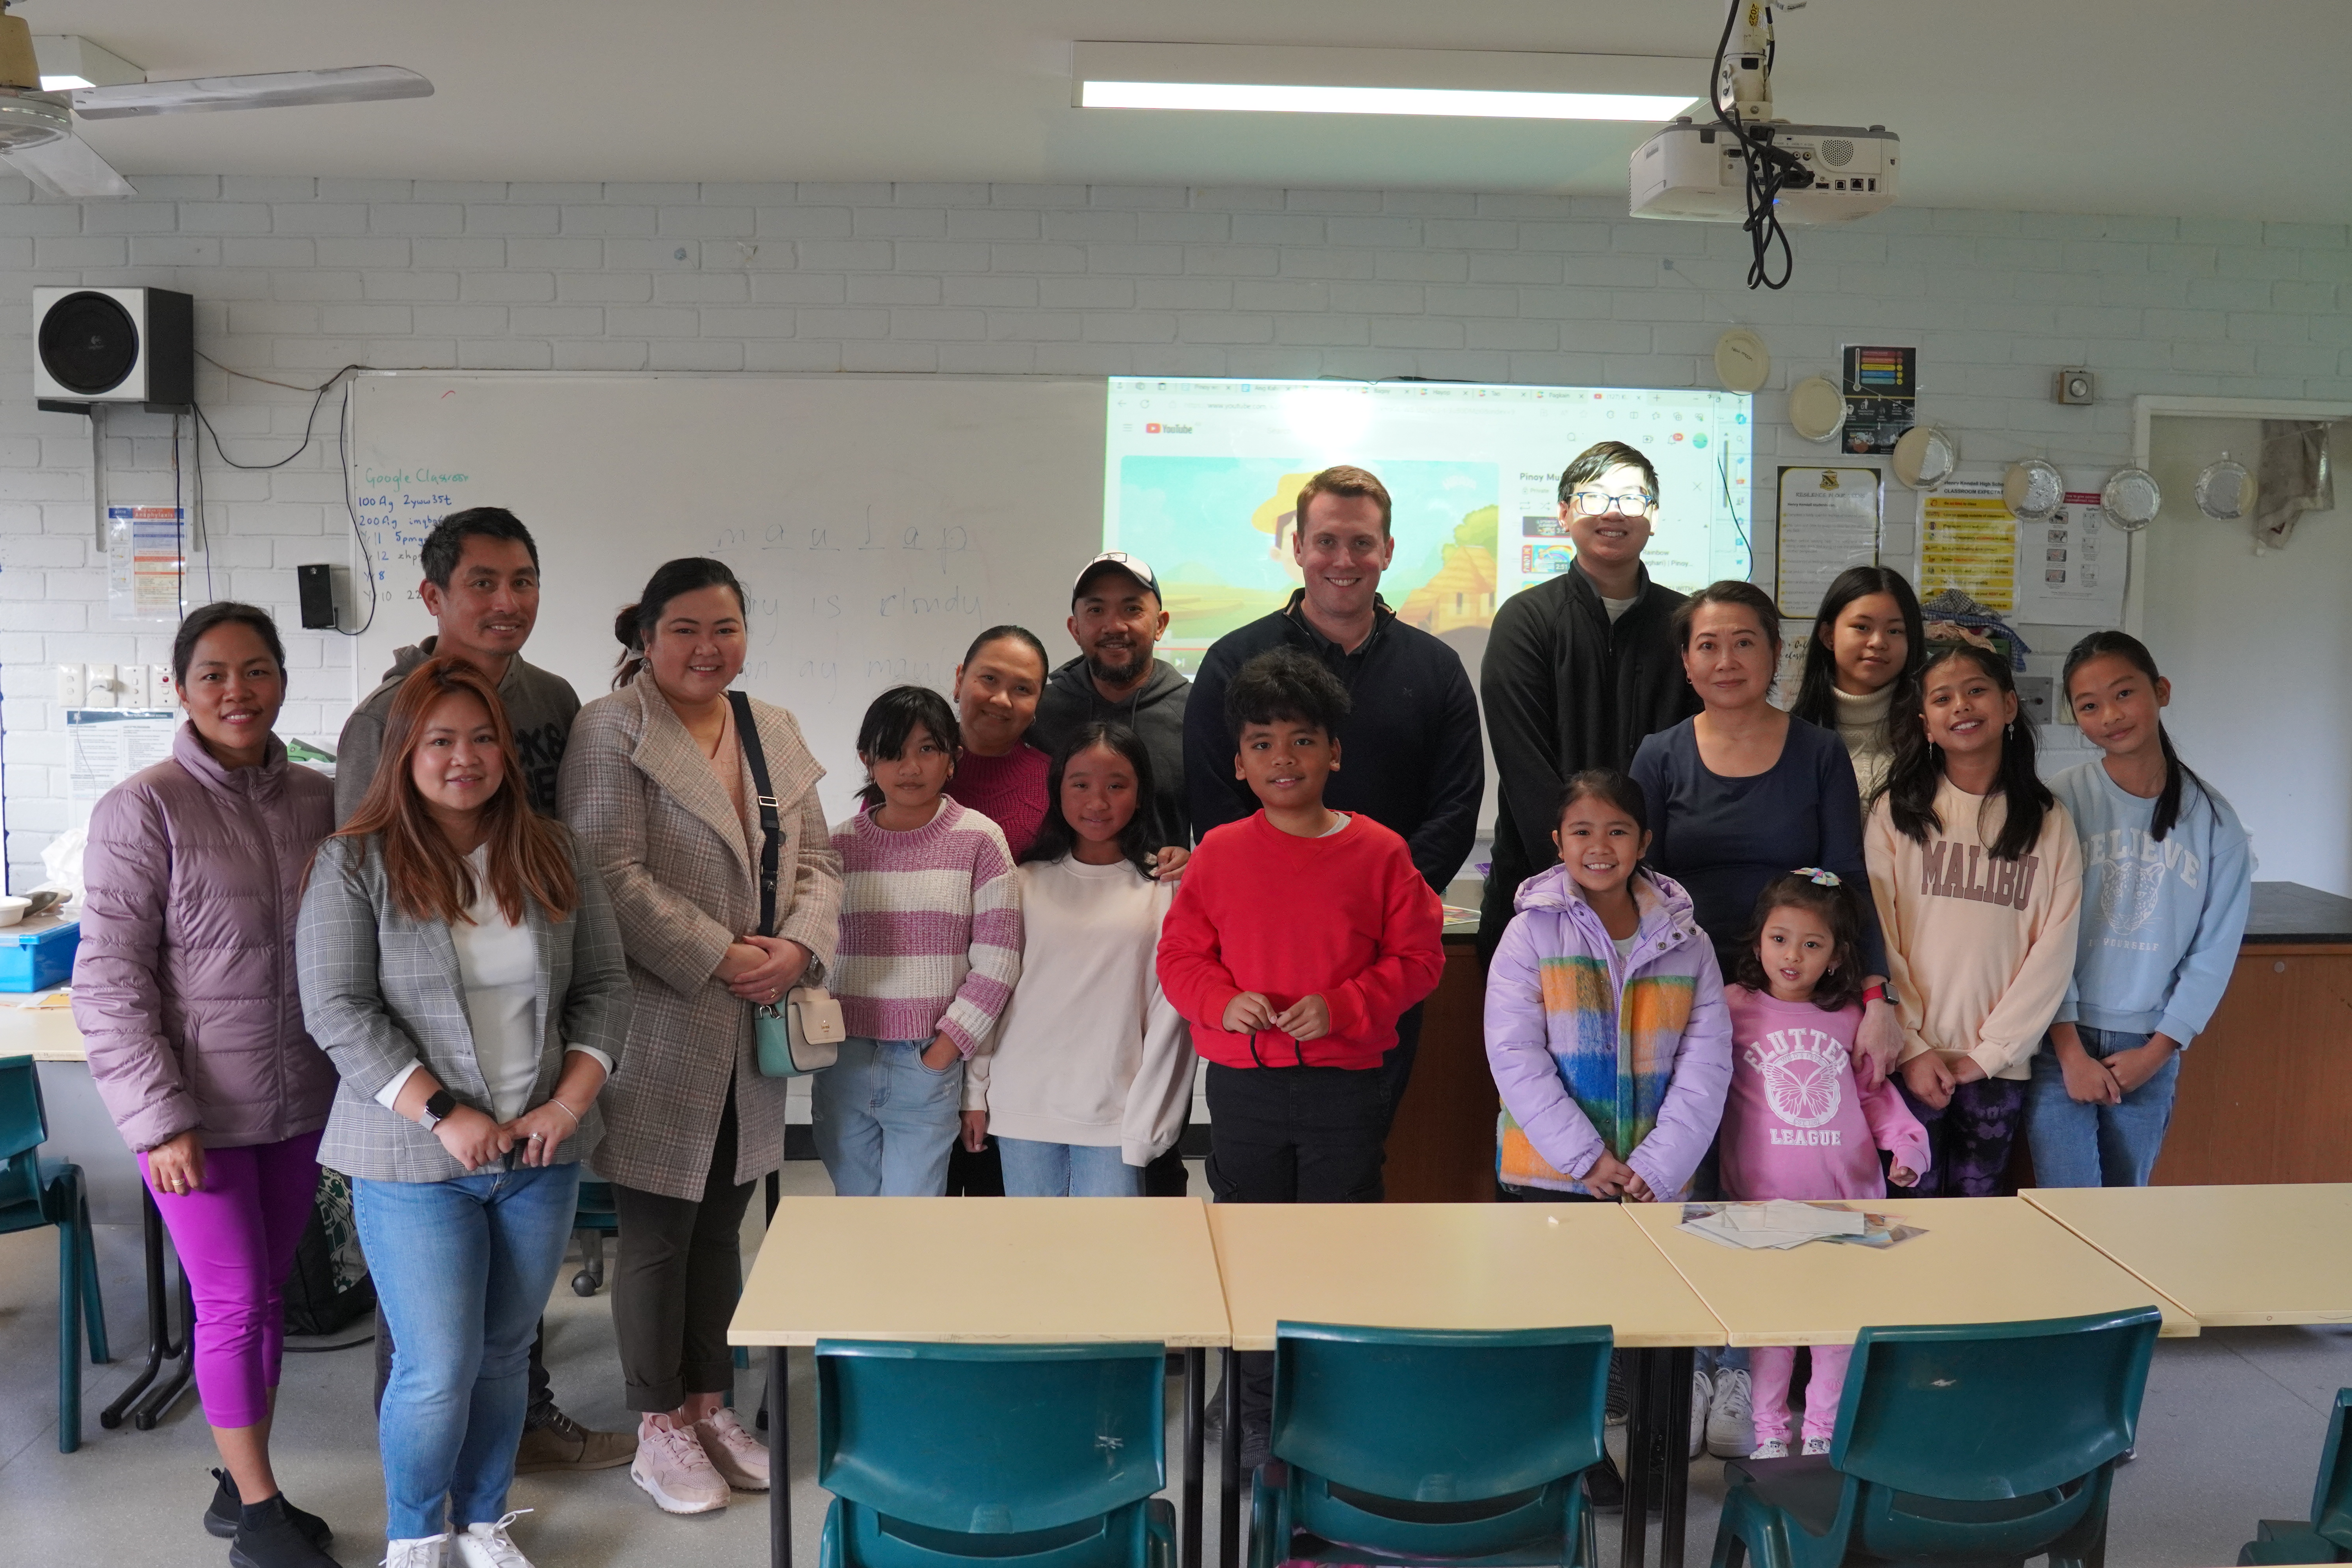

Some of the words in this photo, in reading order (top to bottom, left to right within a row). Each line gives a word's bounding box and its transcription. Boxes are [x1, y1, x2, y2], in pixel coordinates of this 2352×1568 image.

[1162, 424, 1193, 434] YouTube
[365, 467, 412, 492] Google
[1520, 473, 1544, 483] Pinoy
[378, 570, 385, 580] 8
[382, 591, 392, 602] 10
[813, 594, 841, 619] is
[868, 647, 958, 684] maula
[1921, 840, 2040, 911] MALIBU
[2103, 937, 2159, 951] YOURSELF
[1781, 1054, 1795, 1063] WILD
[1806, 1053, 1823, 1064] FREE
[1769, 1128, 1842, 1146] LEAGUE
